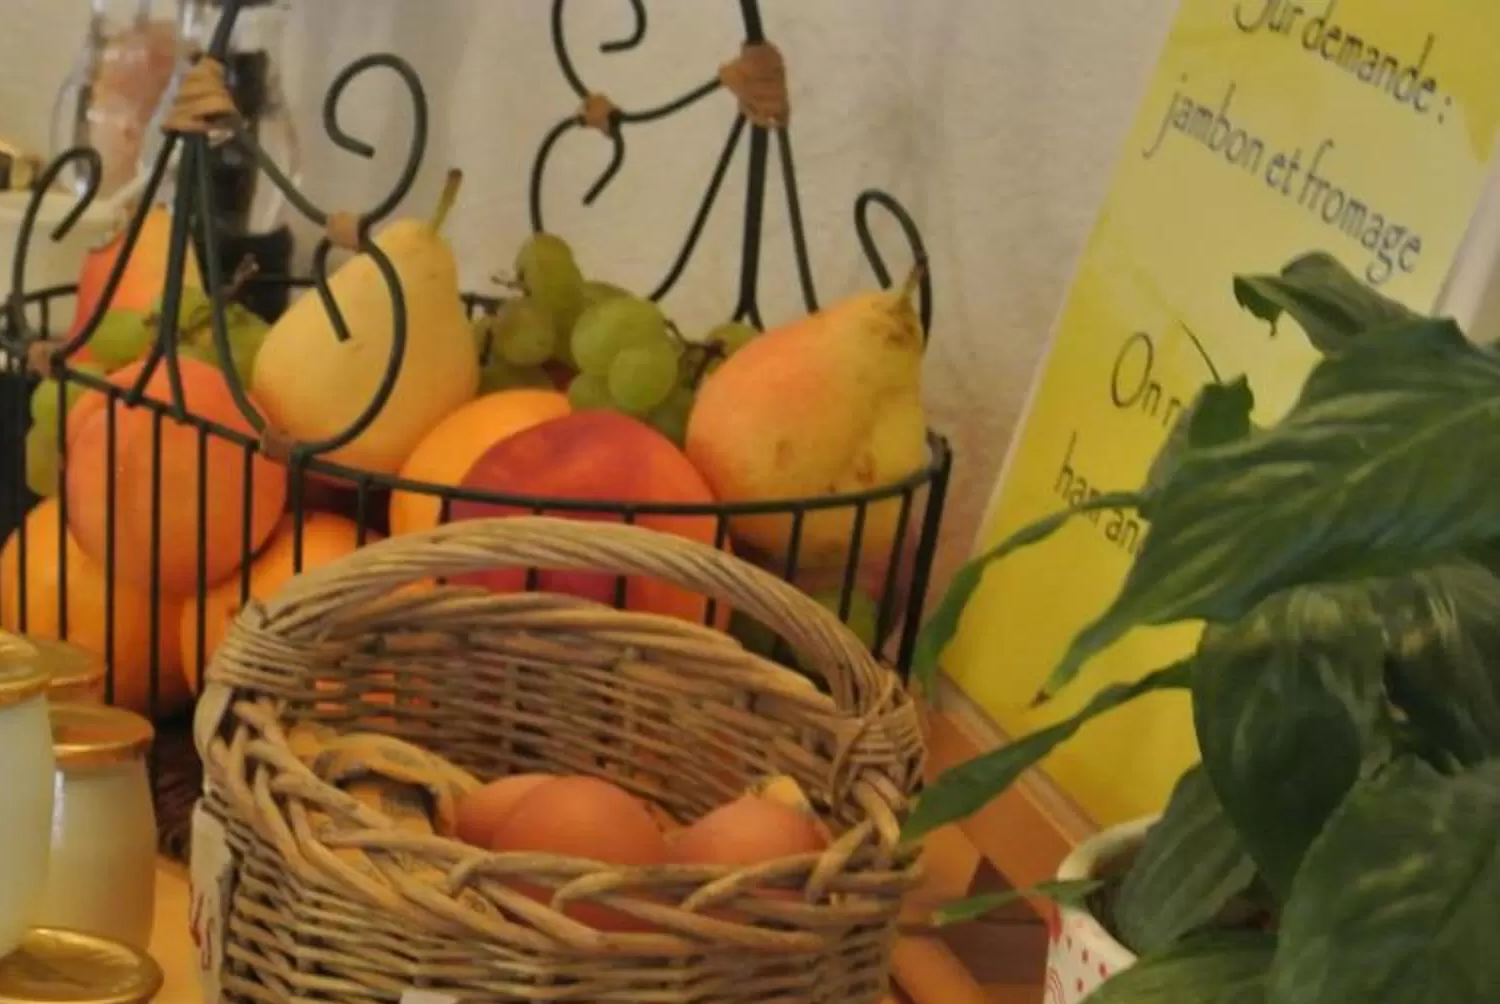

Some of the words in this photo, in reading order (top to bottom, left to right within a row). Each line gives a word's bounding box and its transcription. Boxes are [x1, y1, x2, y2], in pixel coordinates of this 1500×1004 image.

[1301, 0, 1438, 114] demande
[1142, 72, 1266, 177] jambon
[1264, 148, 1303, 197] et
[1296, 138, 1423, 287] fromage
[1110, 331, 1162, 419] On
